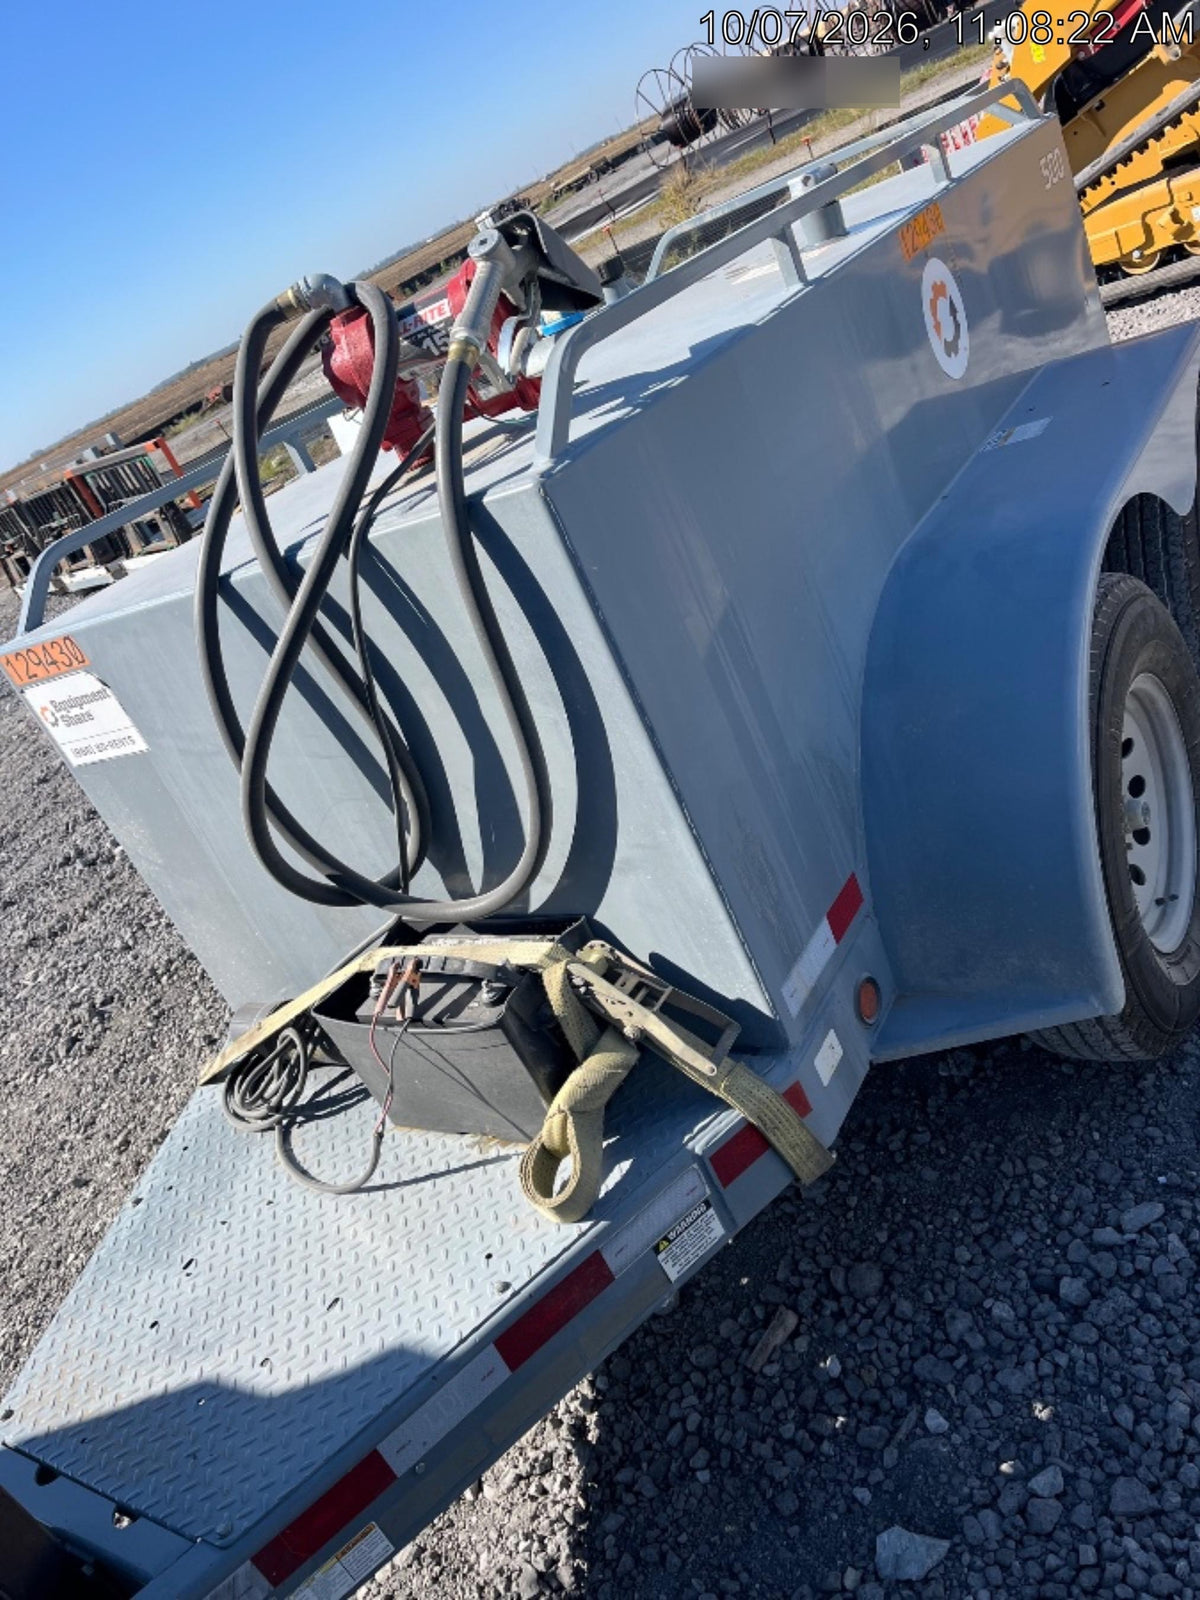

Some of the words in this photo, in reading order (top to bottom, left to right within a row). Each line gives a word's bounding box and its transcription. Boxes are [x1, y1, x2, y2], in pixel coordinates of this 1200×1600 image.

[5, 635, 86, 682] 129430
[49, 688, 111, 713] Equipment
[60, 710, 95, 728] Share
[668, 1203, 707, 1240] WARNING
